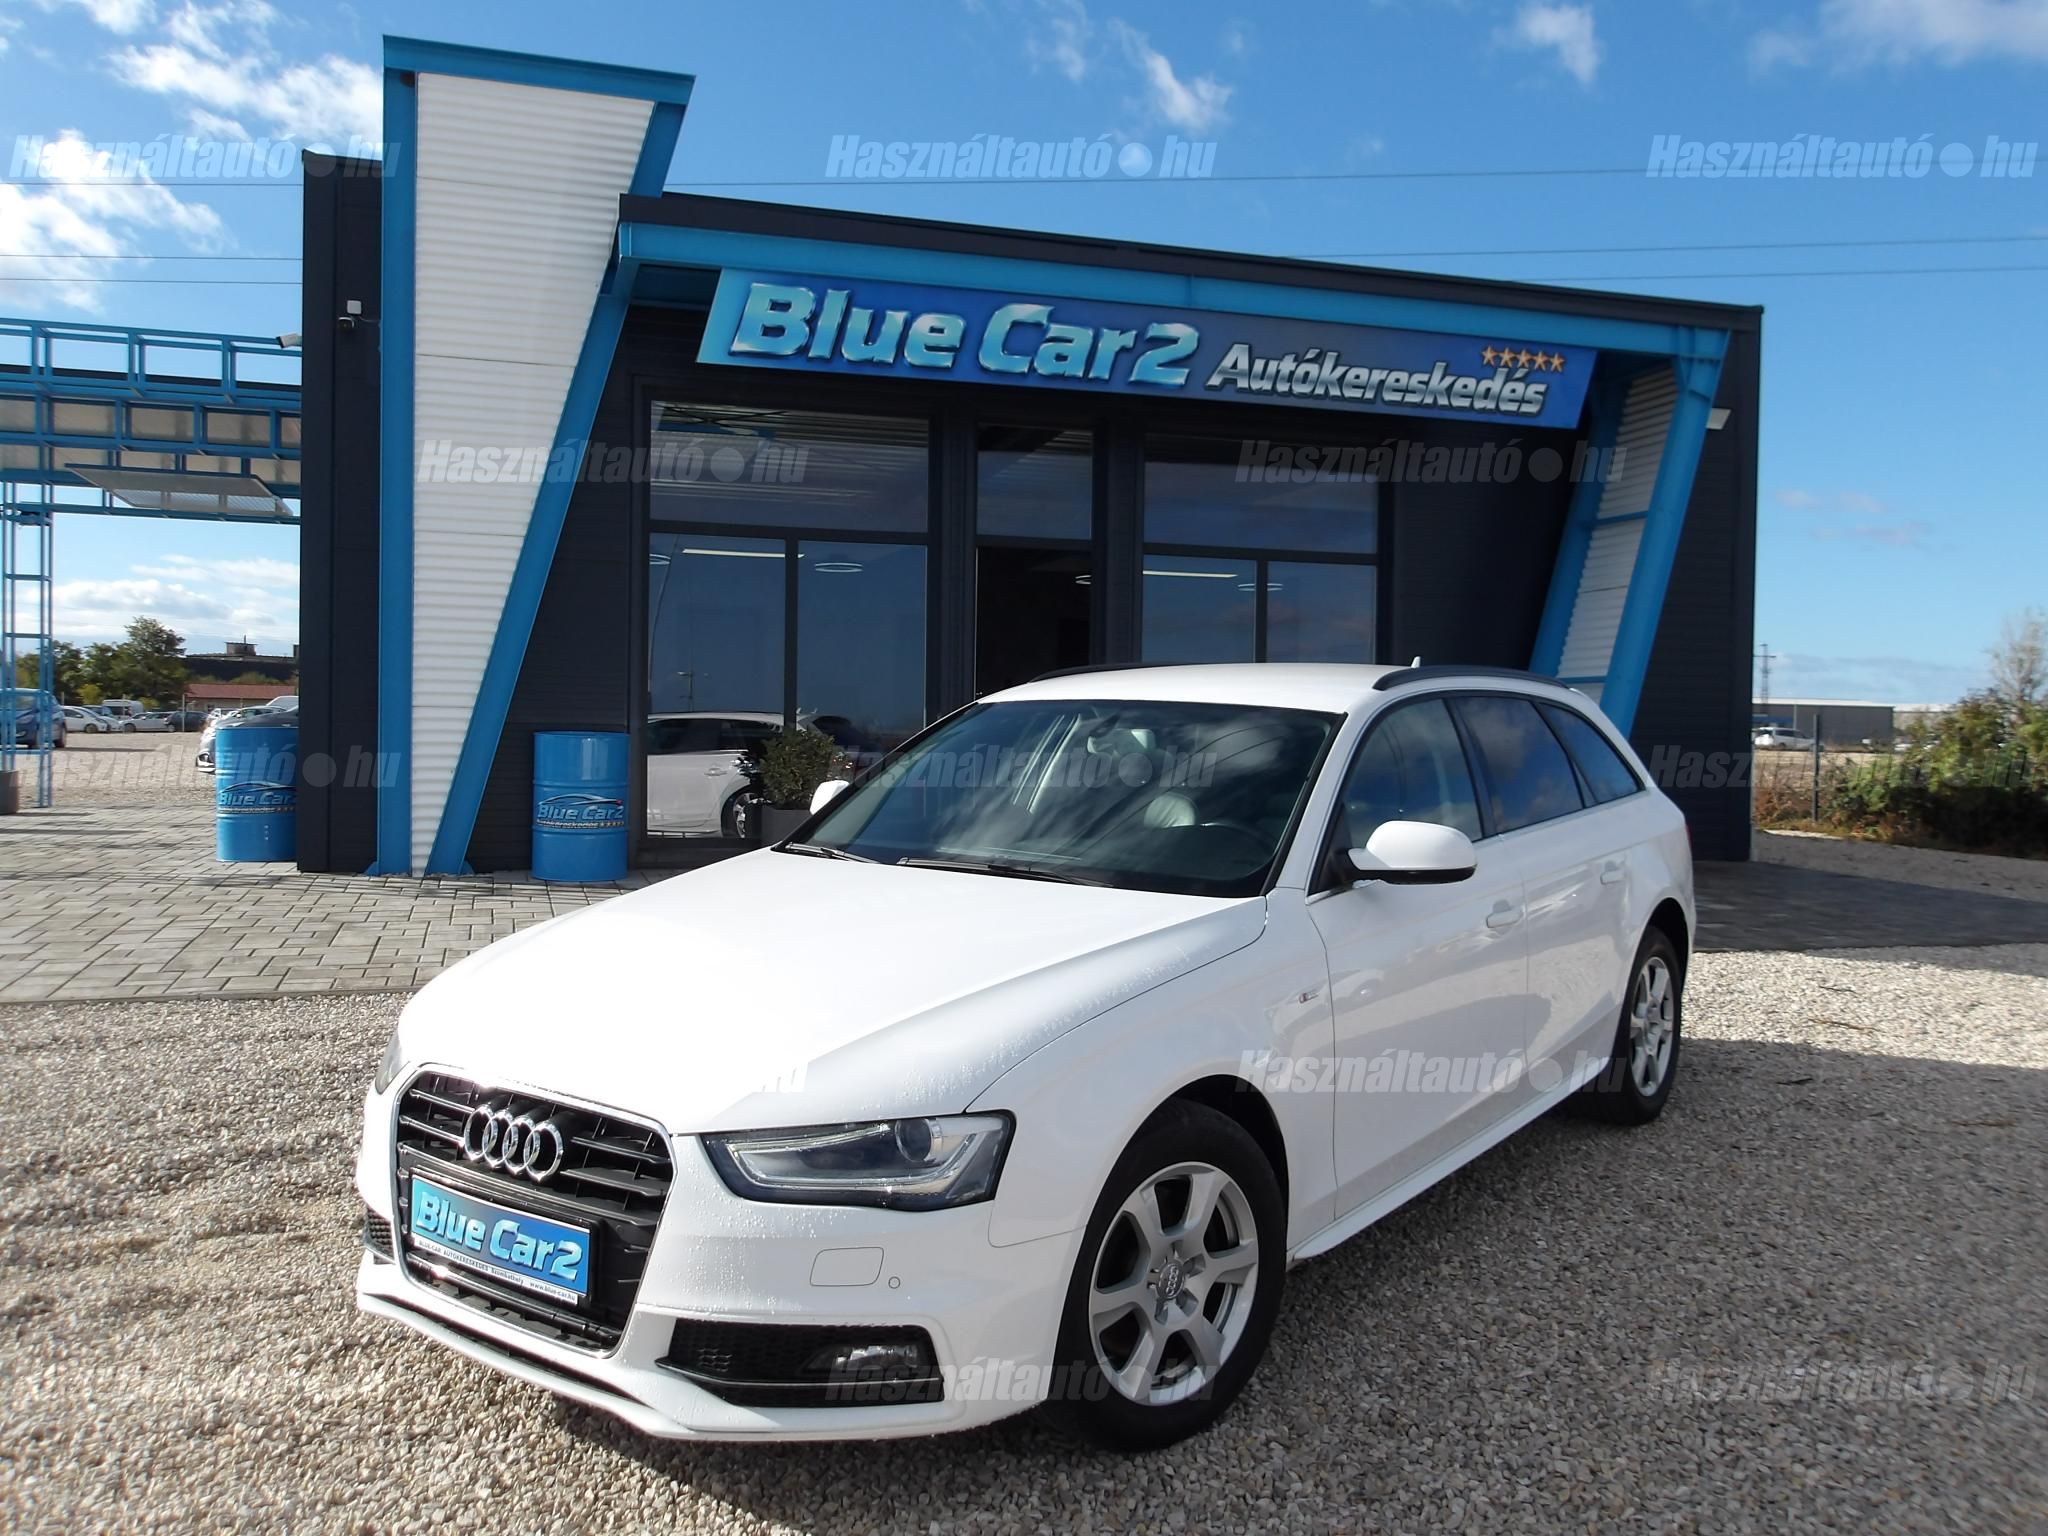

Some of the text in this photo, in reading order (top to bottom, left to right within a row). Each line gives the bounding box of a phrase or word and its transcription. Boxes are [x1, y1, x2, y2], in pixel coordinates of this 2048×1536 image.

[728, 282, 1200, 388] Blue Car2
[1204, 343, 1548, 415] Autókereskedés
[217, 791, 295, 807] Blue Car
[537, 804, 578, 820] Blue
[416, 1190, 583, 1282] Blue Car2
